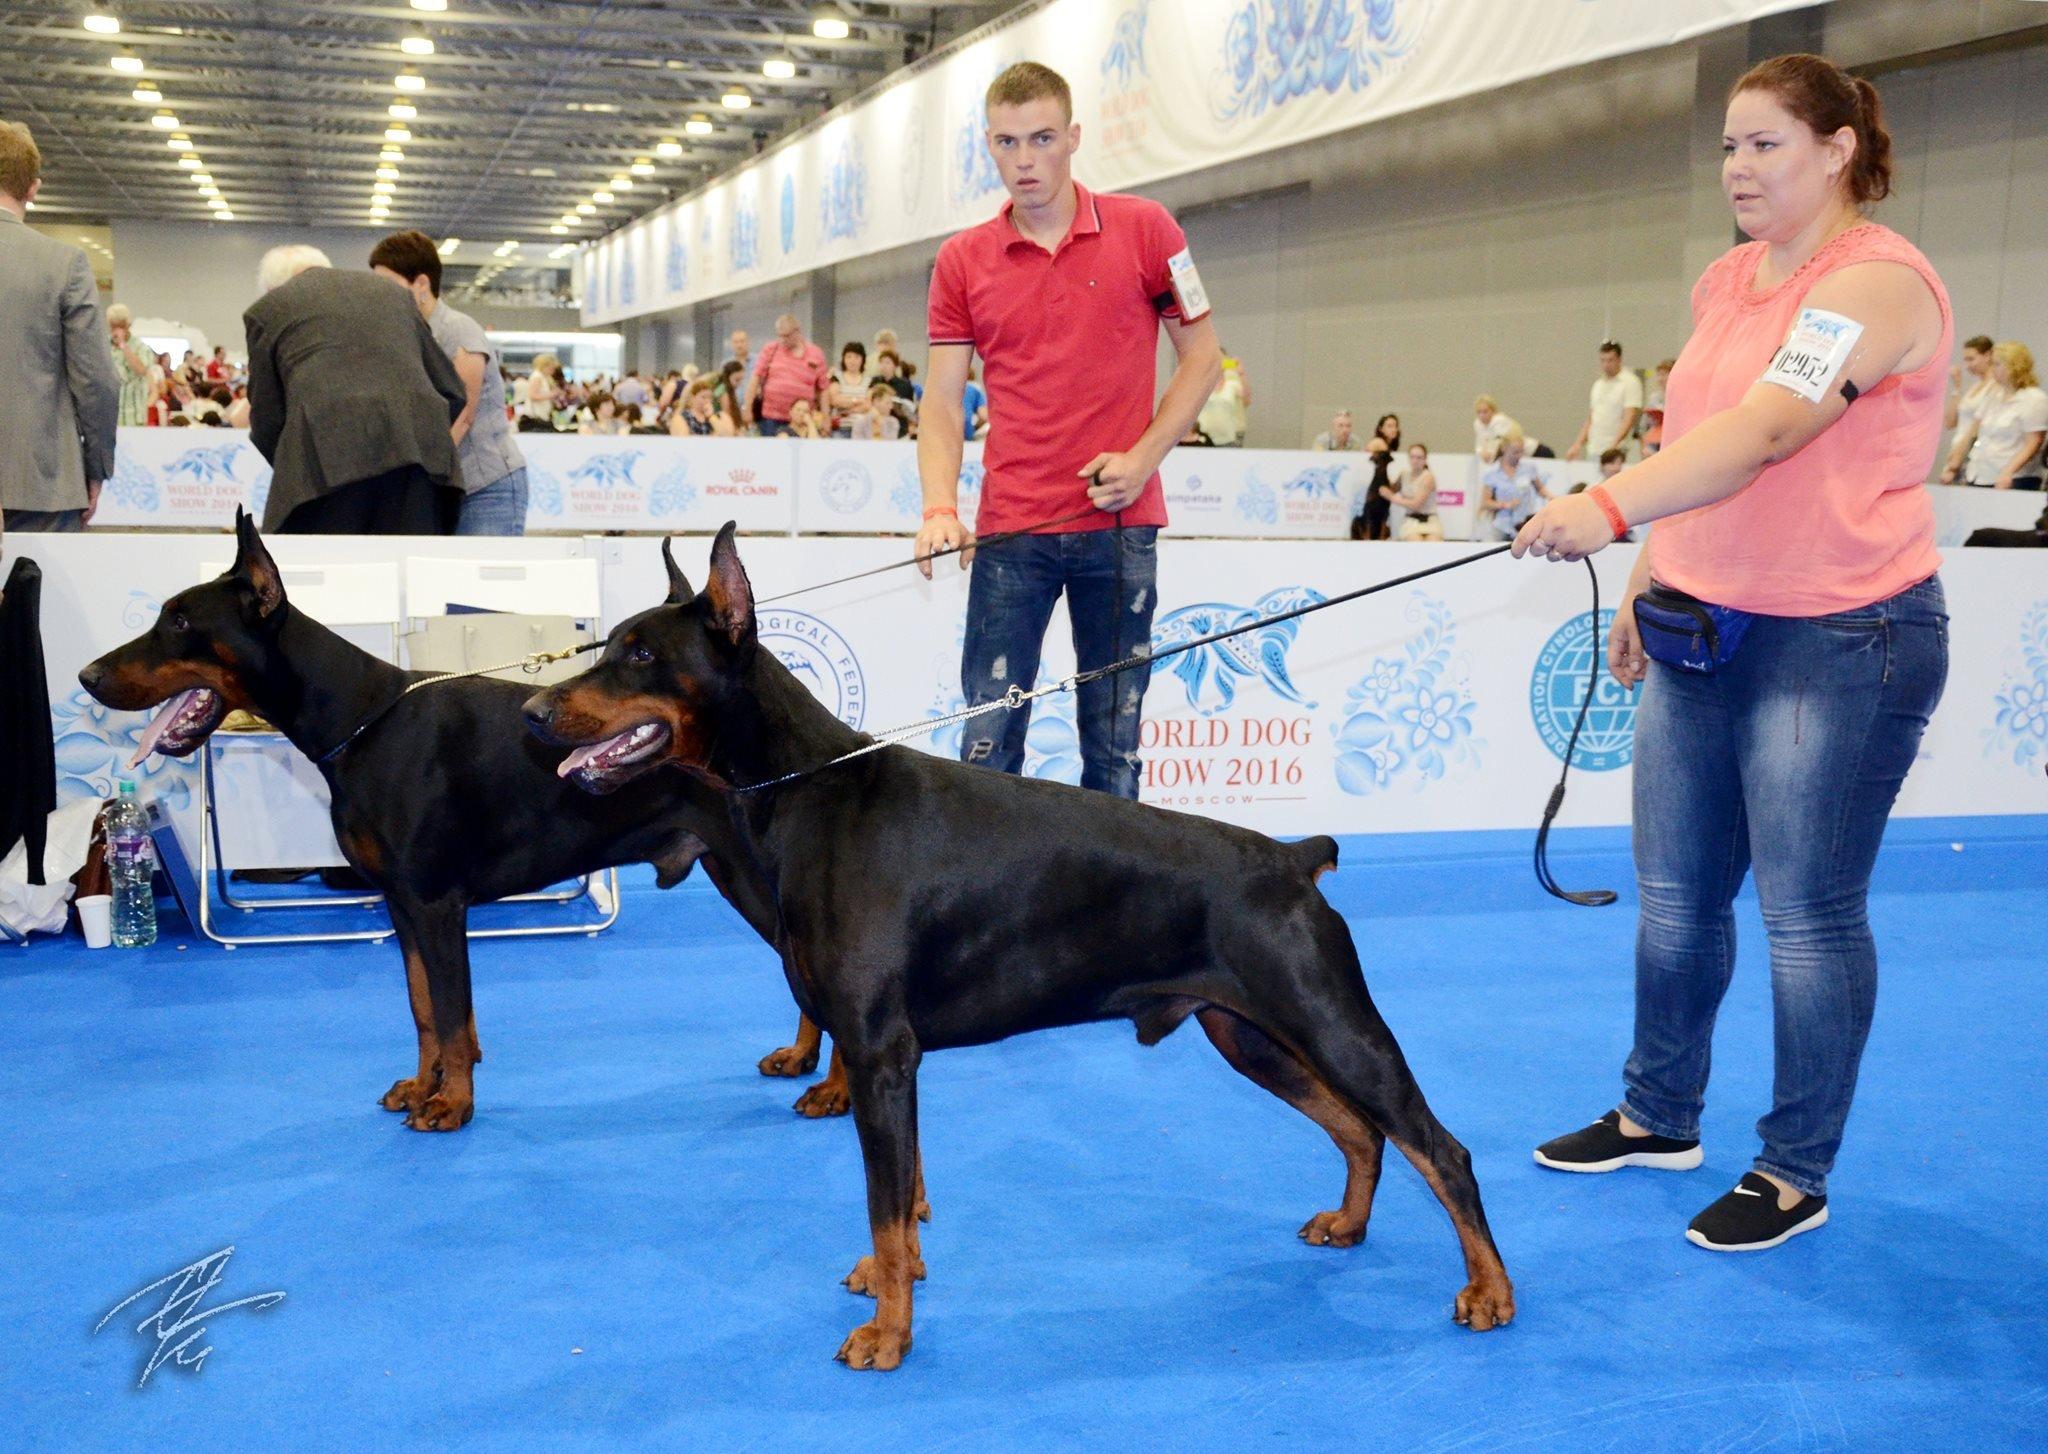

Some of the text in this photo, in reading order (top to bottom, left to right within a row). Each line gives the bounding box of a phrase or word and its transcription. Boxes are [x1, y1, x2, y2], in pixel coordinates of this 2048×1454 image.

[1775, 350, 1829, 387] 02952
[166, 484, 213, 496] WORLD
[571, 490, 612, 501] WORLD
[705, 485, 779, 496] ROYAL CANIN
[168, 498, 205, 509] SHOW
[1540, 611, 1612, 667] CYNOLOGI
[756, 616, 860, 727] OGICAL FEDER
[1138, 717, 1312, 749] ORLD DOG
[1141, 756, 1302, 788] HOW 2016
[1160, 795, 1254, 806] MOSCOW
